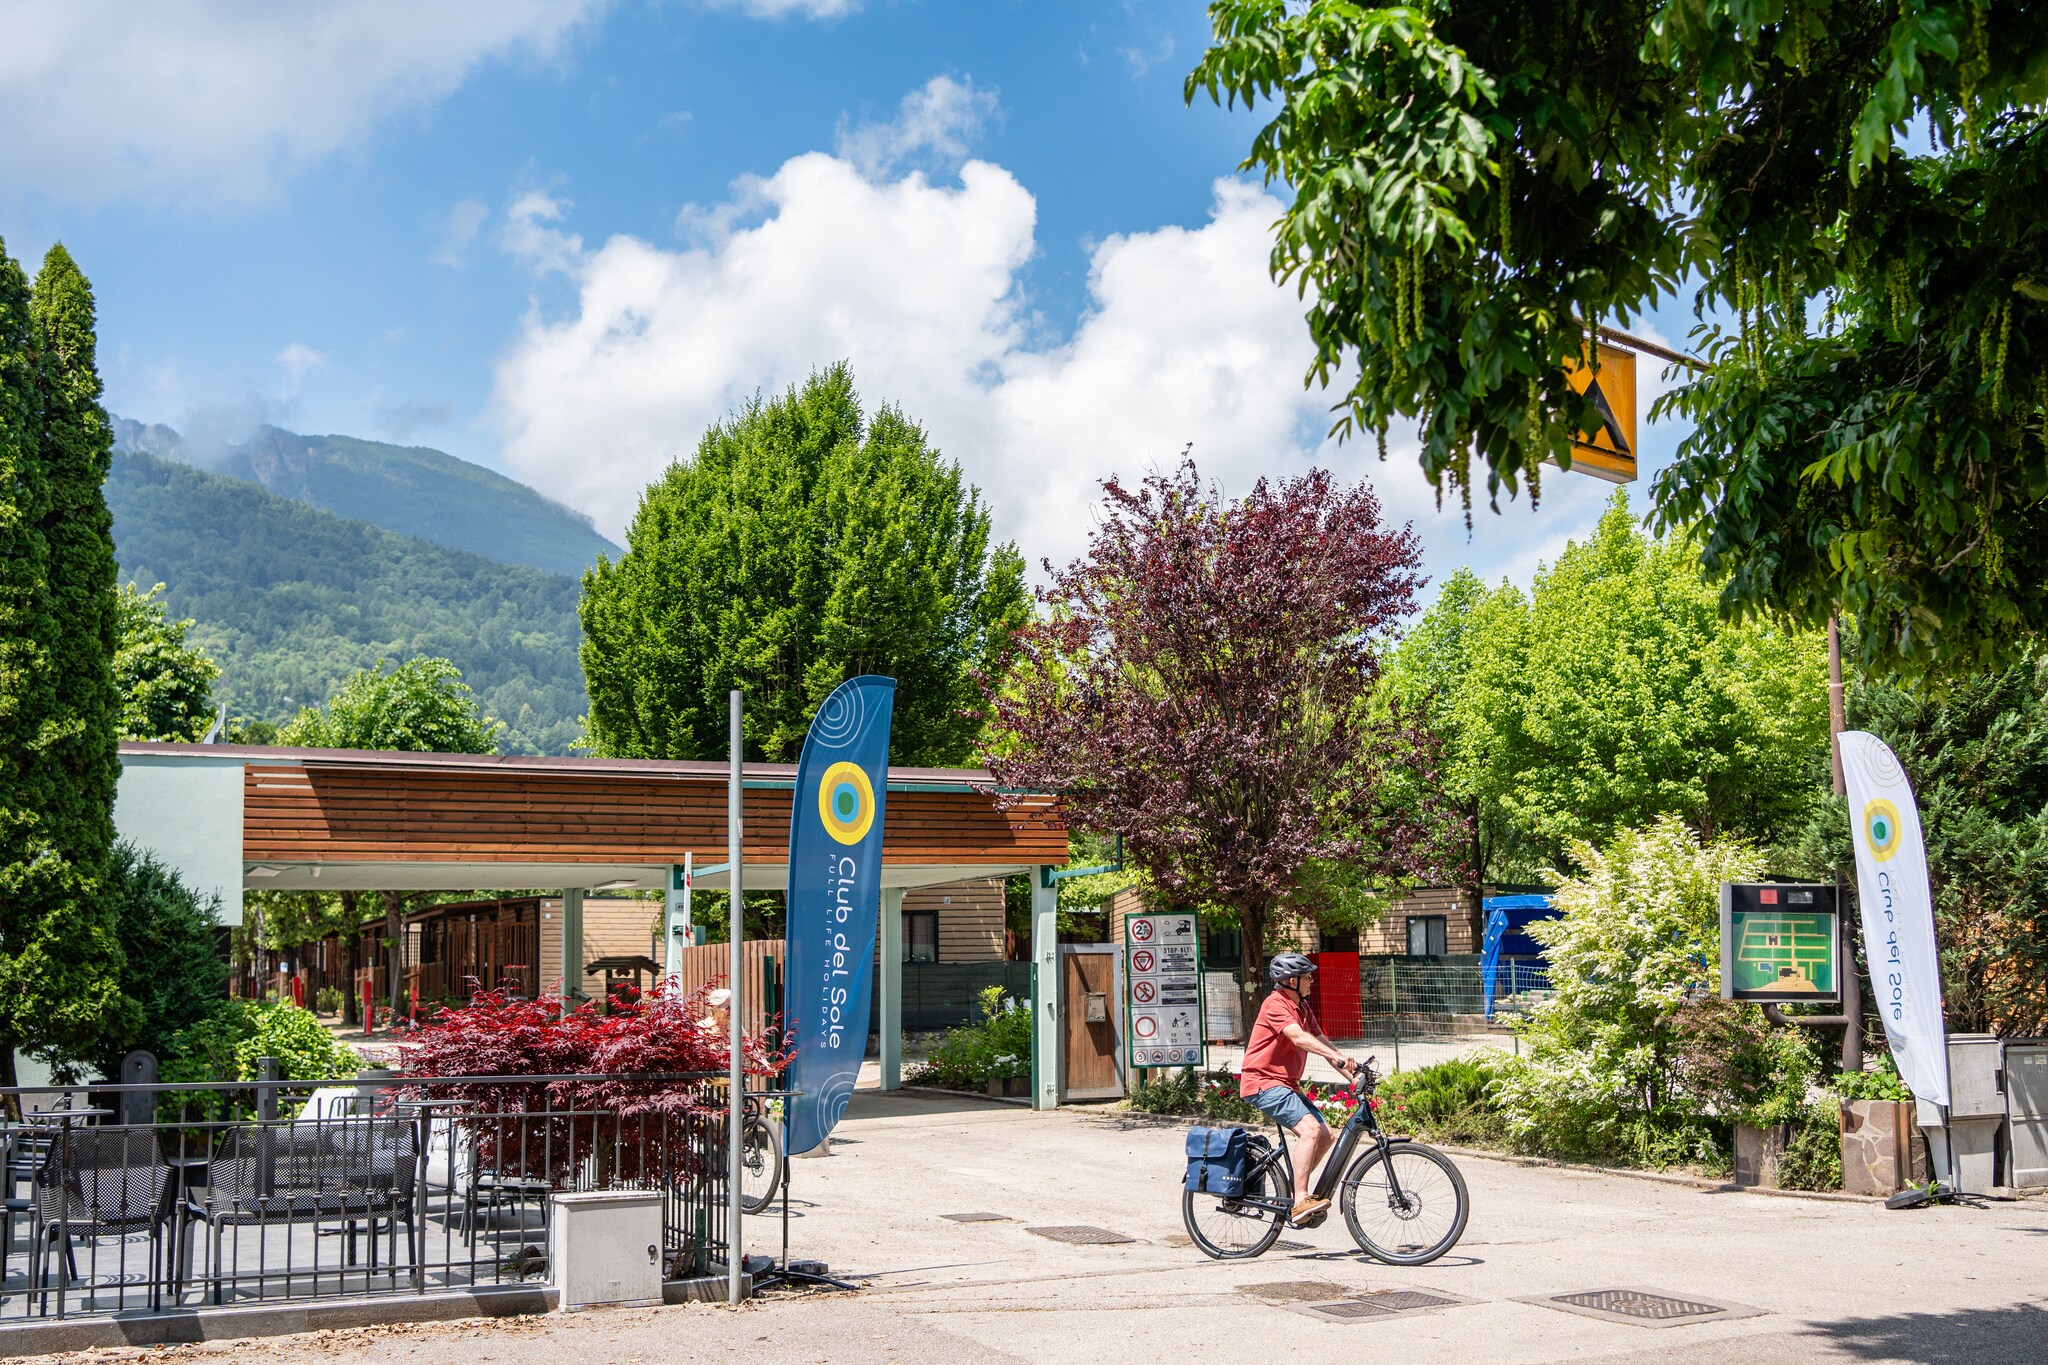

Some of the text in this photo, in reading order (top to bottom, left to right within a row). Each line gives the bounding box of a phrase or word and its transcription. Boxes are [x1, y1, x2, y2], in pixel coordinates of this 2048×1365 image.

[820, 854, 836, 1049] FULL LIFE HOLIDAYS
[829, 856, 856, 1049] Club del Sole
